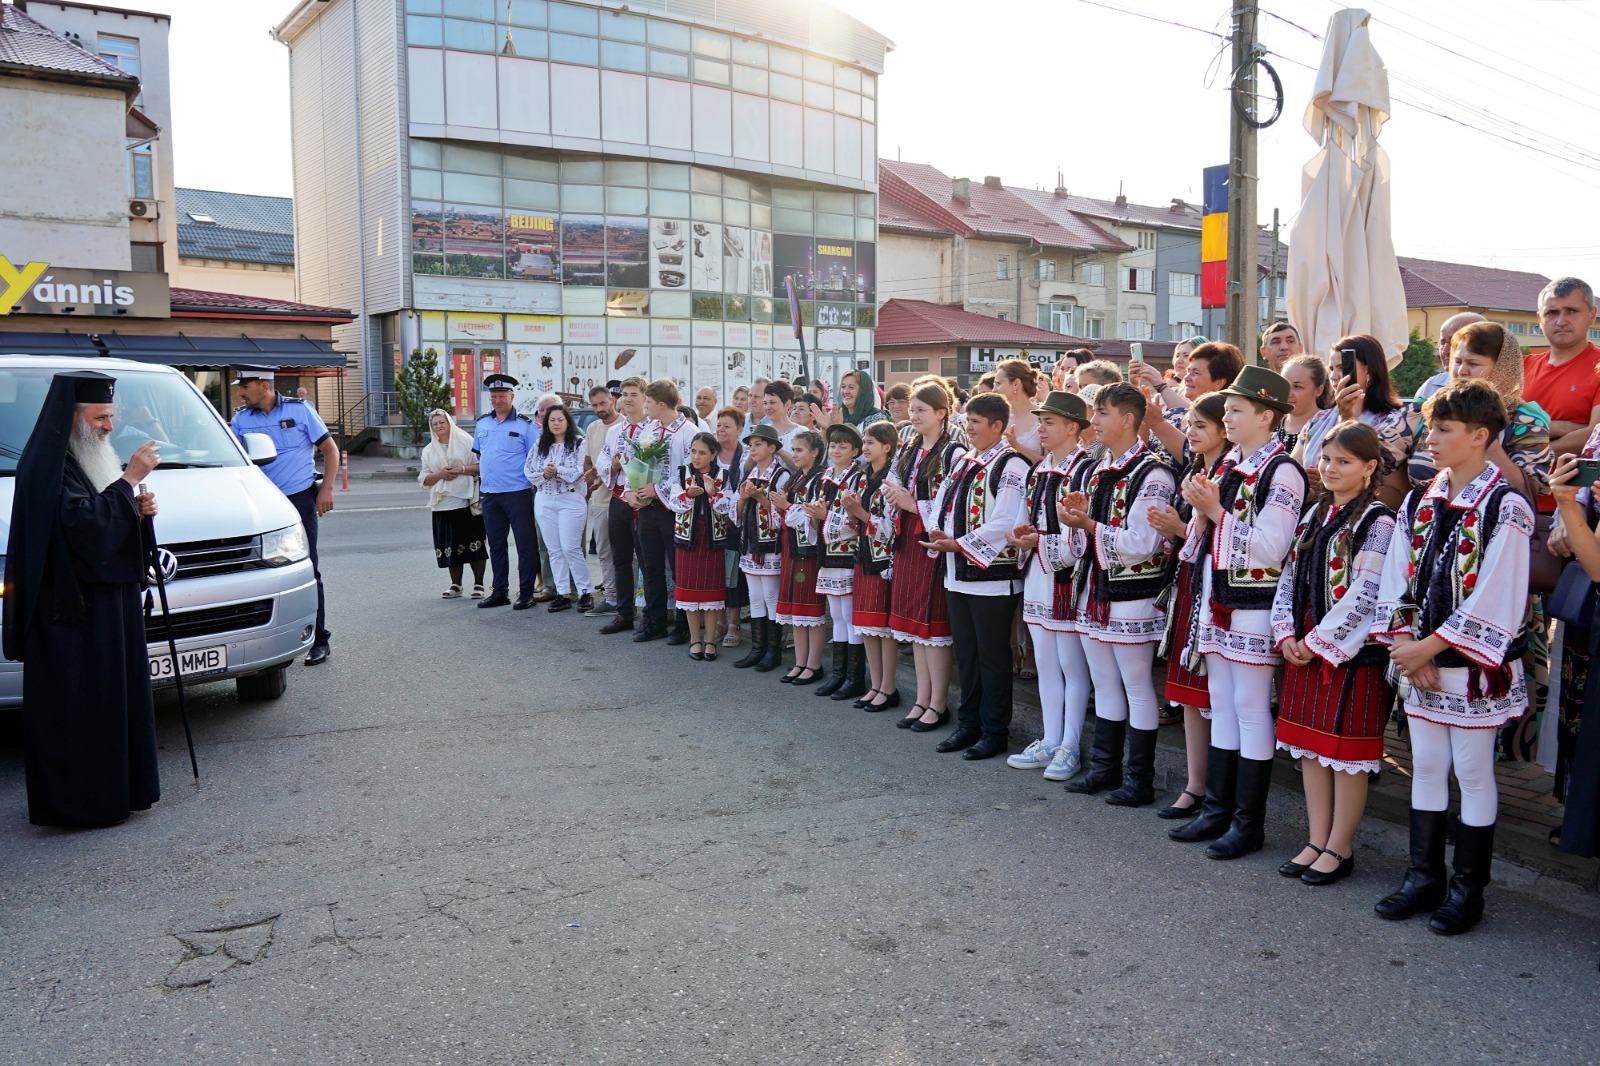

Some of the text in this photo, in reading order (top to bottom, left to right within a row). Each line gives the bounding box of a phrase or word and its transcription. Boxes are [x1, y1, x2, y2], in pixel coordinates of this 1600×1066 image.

[510, 214, 554, 231] BEIJING
[817, 244, 853, 257] SHANGHAI
[460, 355, 468, 415] INTRARE
[182, 650, 220, 672] MMB
